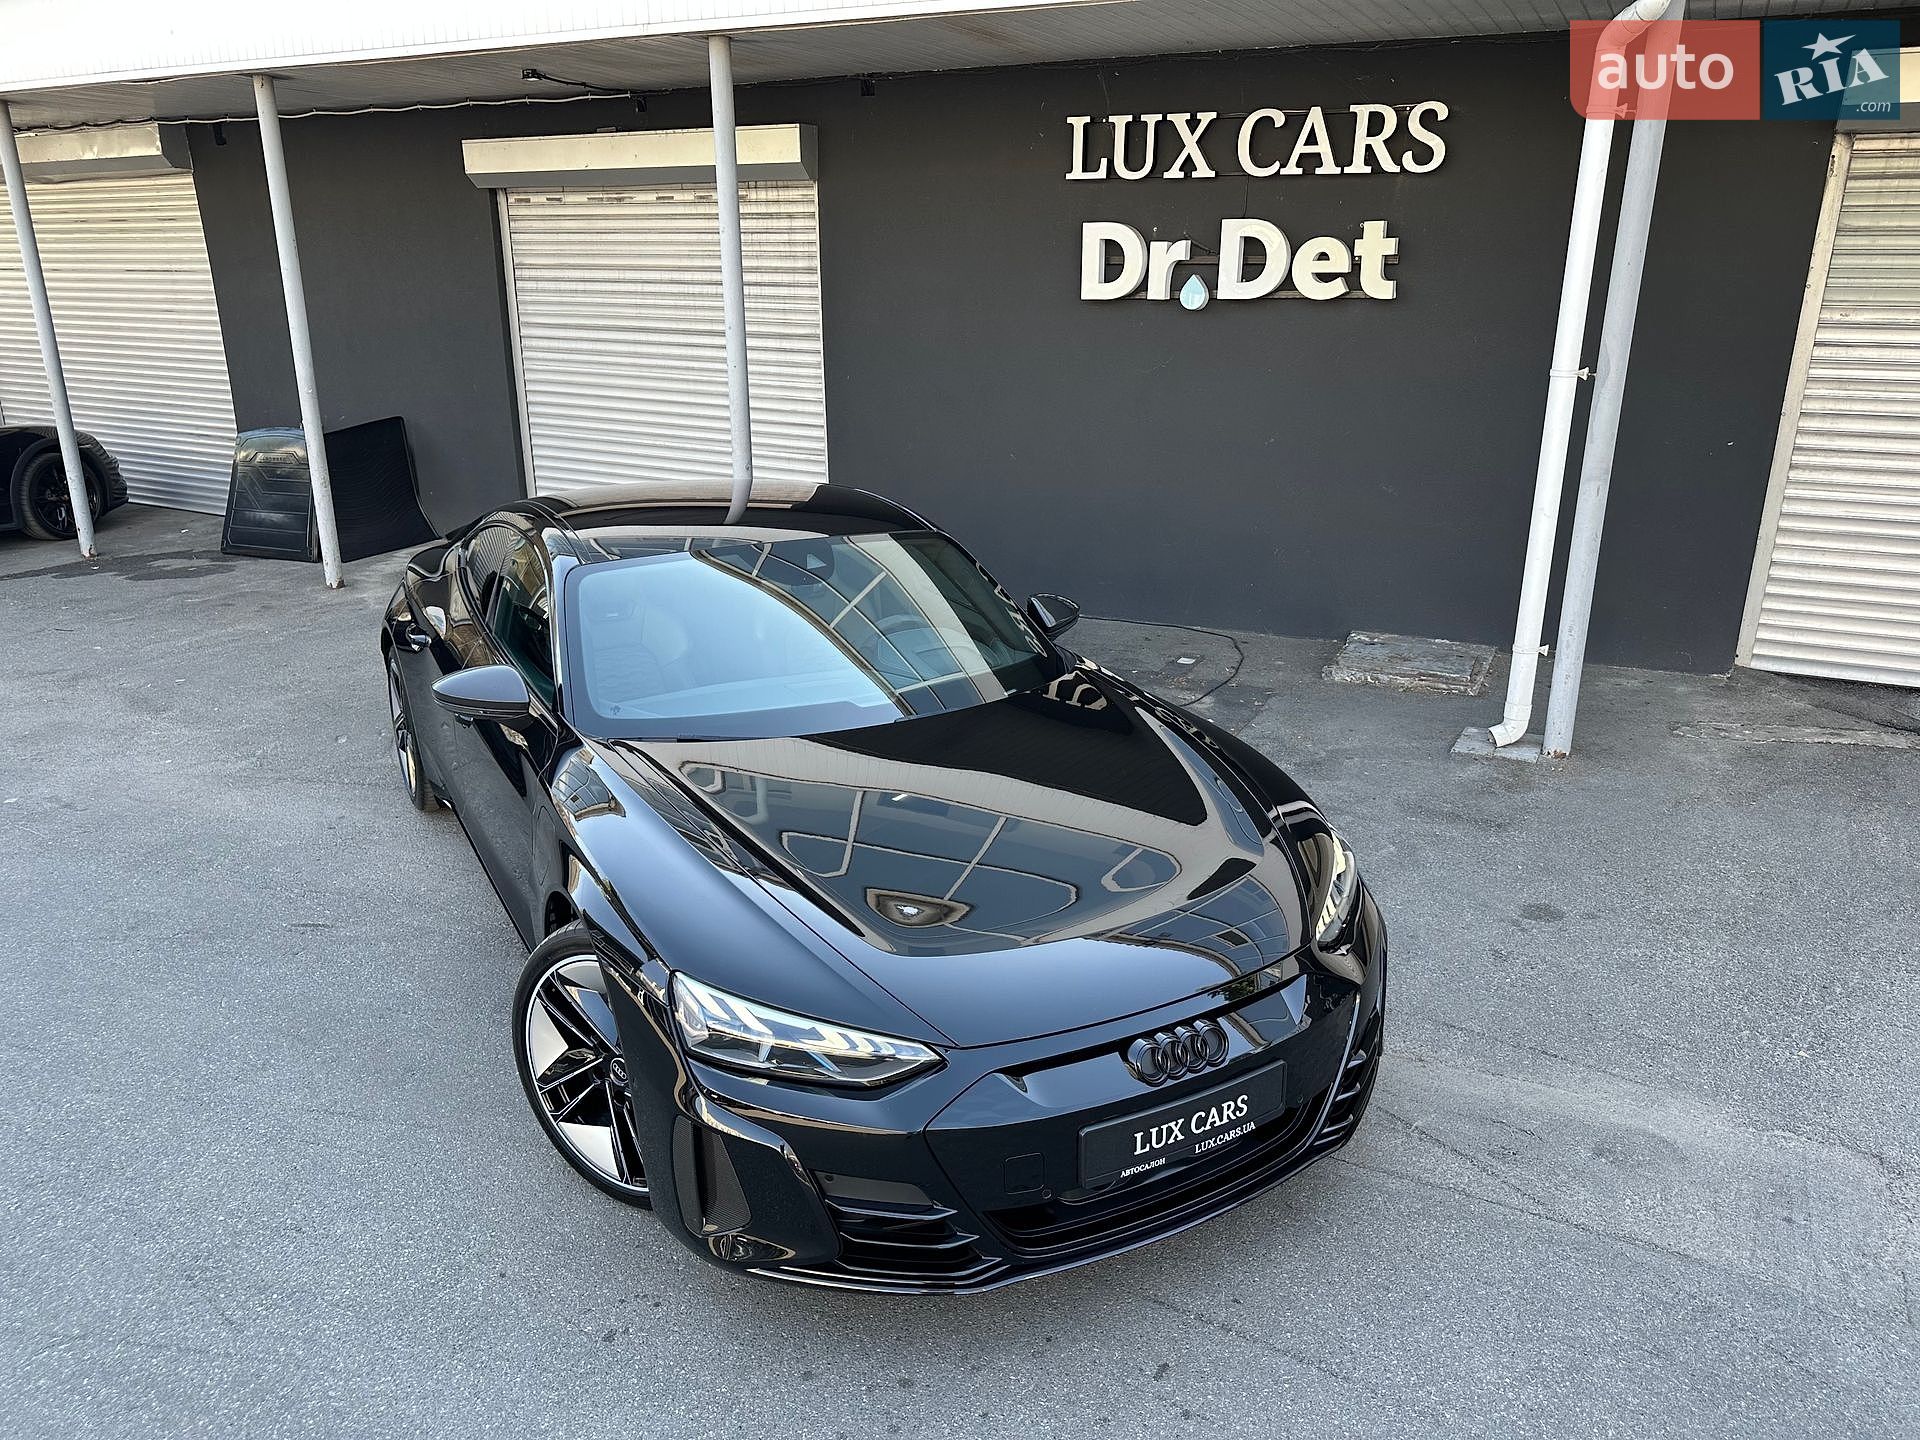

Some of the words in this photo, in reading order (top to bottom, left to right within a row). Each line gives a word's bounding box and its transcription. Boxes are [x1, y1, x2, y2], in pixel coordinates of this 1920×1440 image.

[1065, 112, 1218, 181] LUX
[1237, 100, 1449, 178] CARS
[1133, 1118, 1186, 1156] LUX
[1190, 1094, 1249, 1135] CARS
[1194, 1121, 1257, 1154] LUX.CARS.UA
[1119, 1157, 1167, 1178] АВТОСАЛОН
